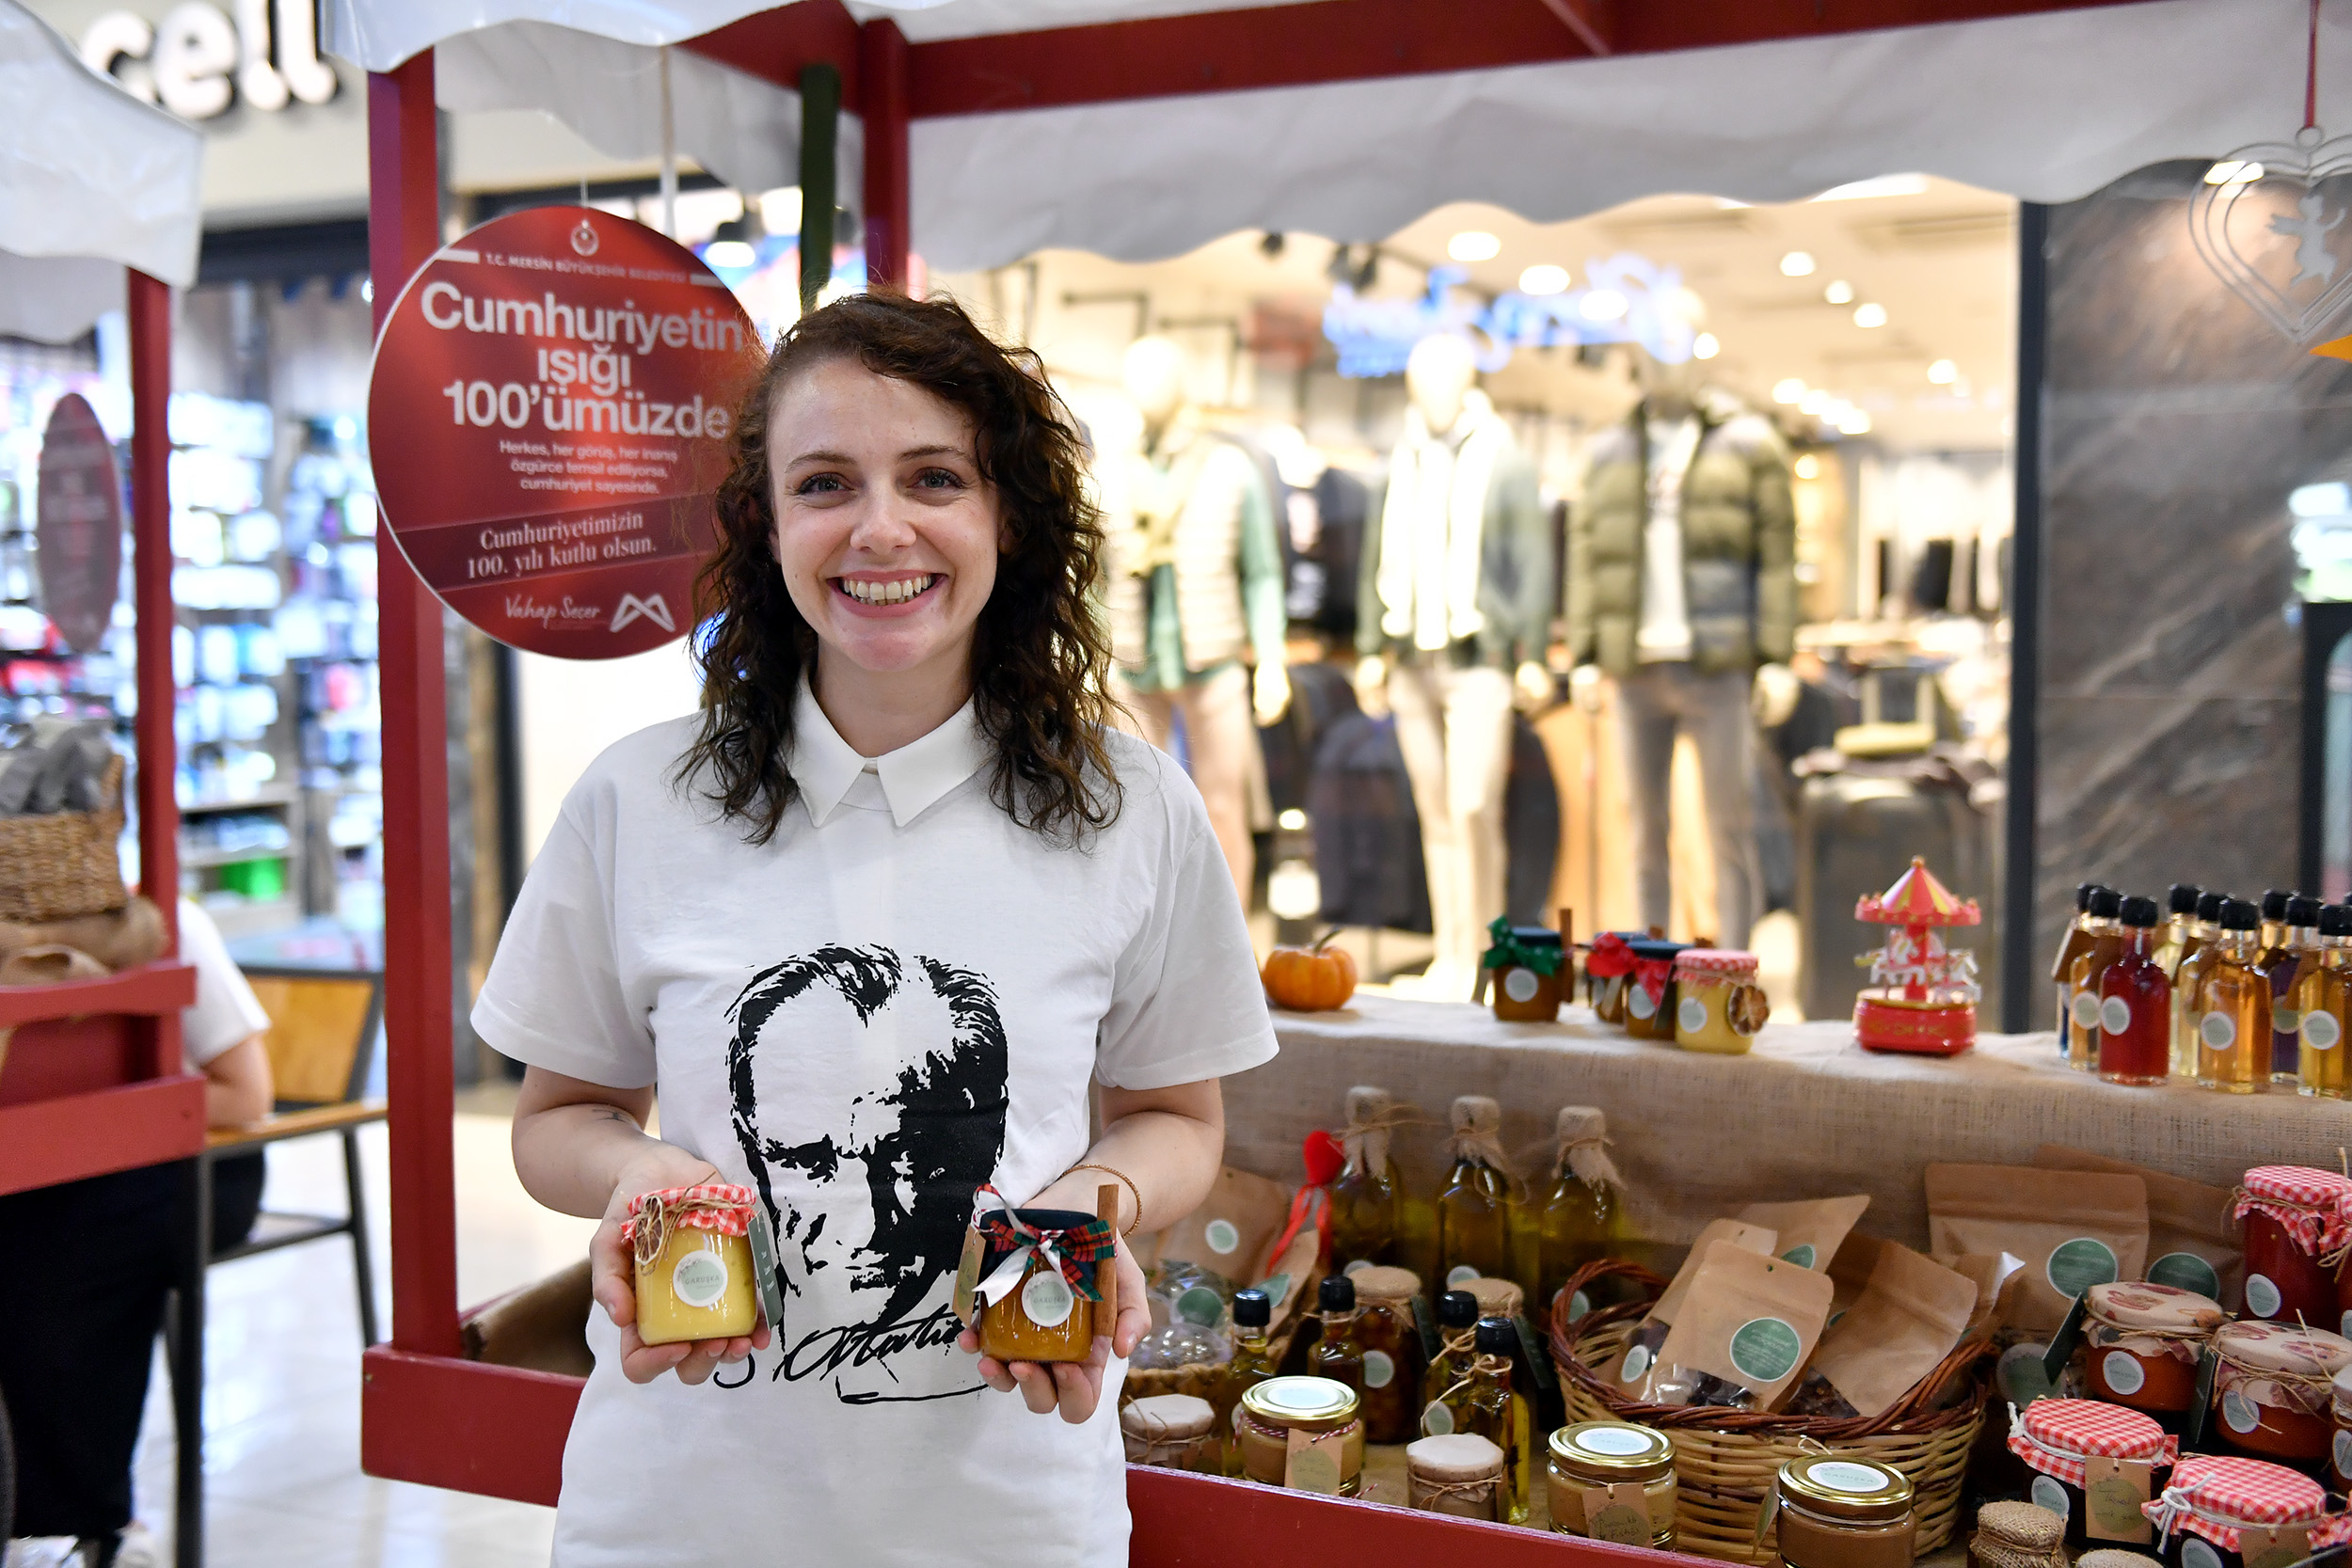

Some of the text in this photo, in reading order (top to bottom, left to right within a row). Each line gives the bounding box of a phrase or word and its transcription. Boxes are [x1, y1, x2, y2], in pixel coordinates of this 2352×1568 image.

[485, 252, 506, 267] T.C.
[508, 254, 553, 272] MERSİN
[421, 280, 743, 354] Cumhuriyetin
[537, 341, 632, 397] ışığı
[442, 378, 731, 439] 100'ümüzde
[499, 440, 550, 457] Herkes,
[552, 443, 574, 457] her
[619, 446, 640, 460] her
[510, 458, 564, 476] özgürce
[519, 477, 593, 494] cumhuriyet
[479, 512, 644, 552] Cumhuriyetimizin
[468, 535, 658, 579] 100. yılı kutlu olsun.
